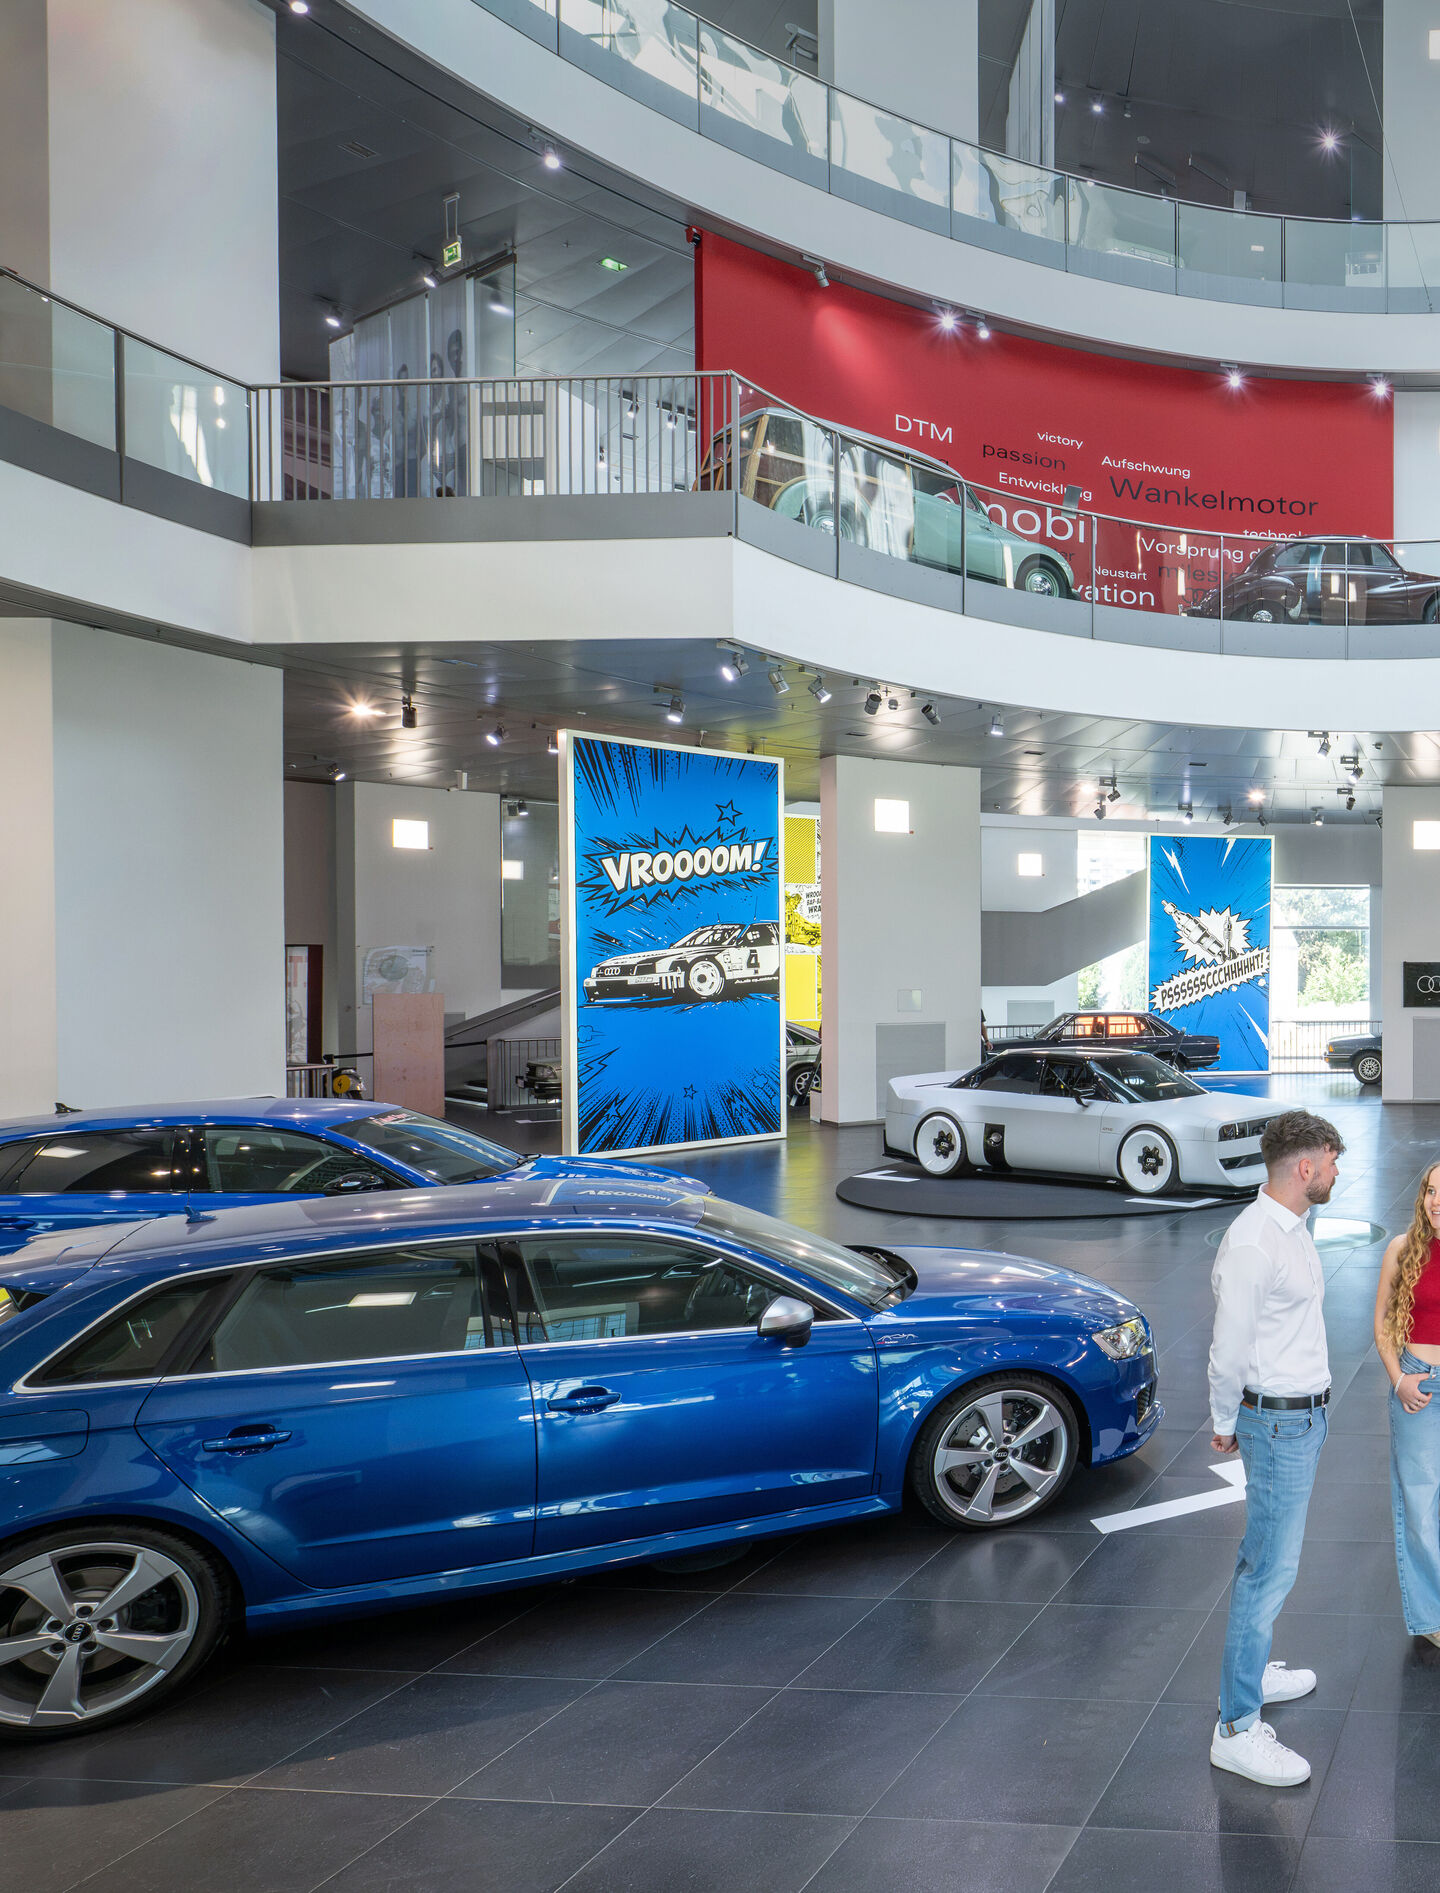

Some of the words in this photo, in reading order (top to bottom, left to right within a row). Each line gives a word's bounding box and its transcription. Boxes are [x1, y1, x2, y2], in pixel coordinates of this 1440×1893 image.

[894, 414, 953, 444] DTM
[1037, 431, 1083, 449] victory
[982, 443, 1066, 472] passion
[1101, 455, 1191, 479] Aufschwung
[999, 472, 1092, 501] Entwicklg
[1109, 475, 1319, 516] Wankelmotor
[1095, 565, 1147, 581] Neustart
[601, 840, 768, 892] VROOOOM!
